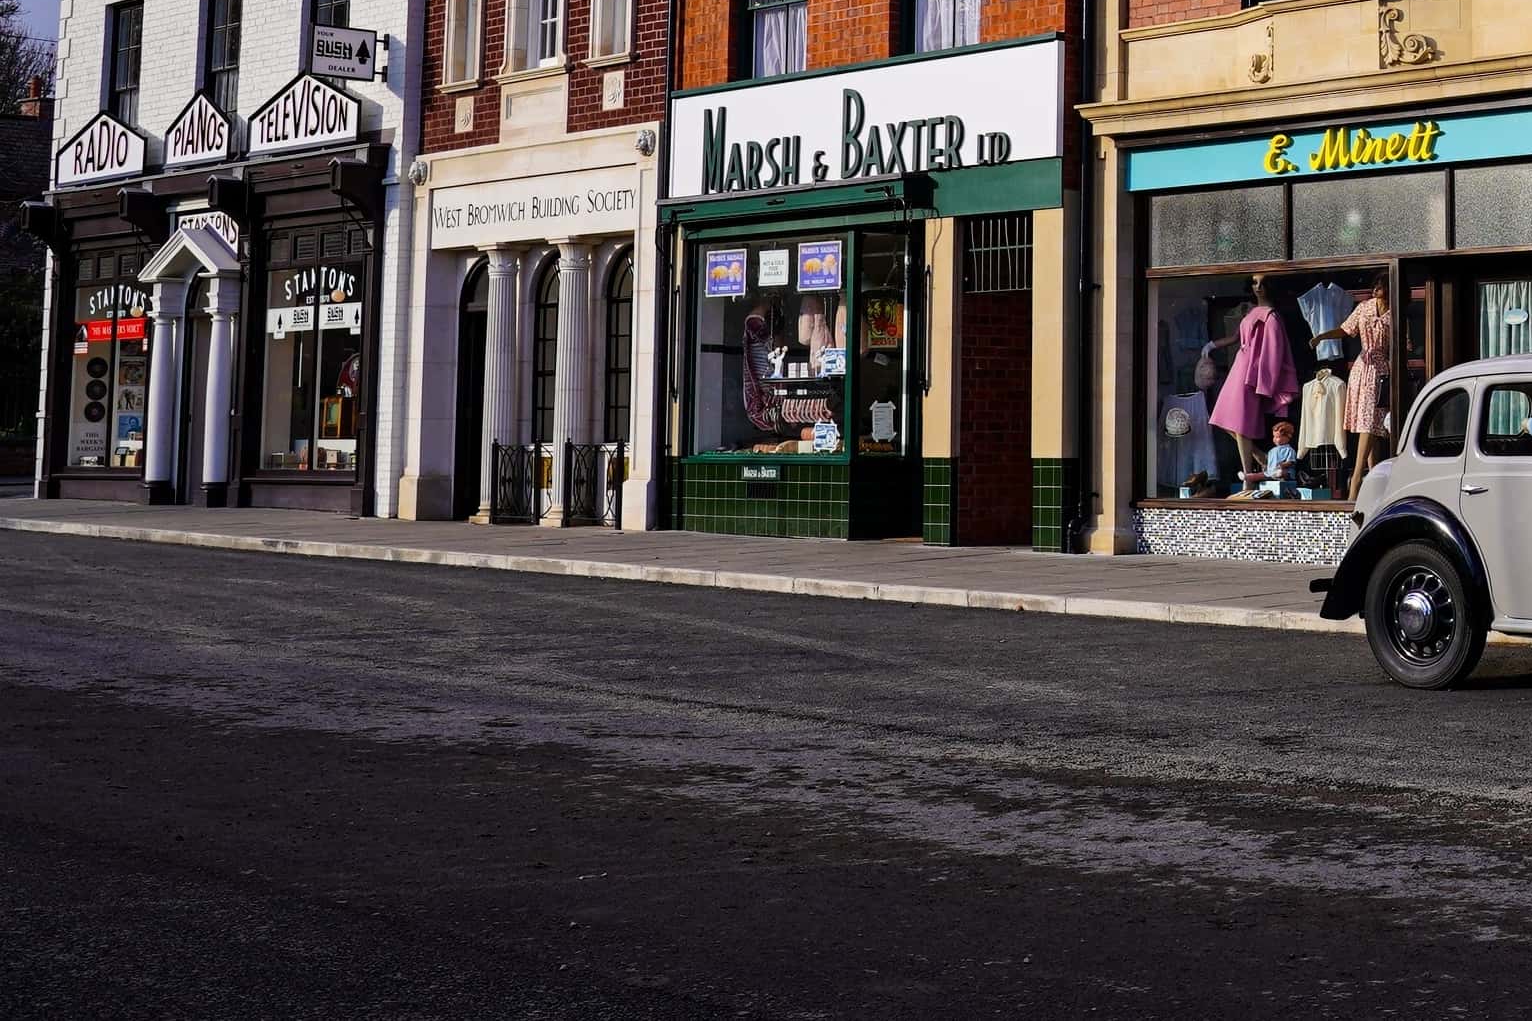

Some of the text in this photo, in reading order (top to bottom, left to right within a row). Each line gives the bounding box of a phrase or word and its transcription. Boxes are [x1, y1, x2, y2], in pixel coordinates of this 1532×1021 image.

[315, 39, 353, 60] BUSH
[328, 65, 356, 73] DEALER
[173, 103, 225, 158] PIANOS
[259, 80, 349, 144] TELEVISION
[74, 120, 128, 175] RADIO
[702, 106, 801, 195] MARSH
[812, 150, 828, 182] &
[841, 88, 965, 180] BAXTER
[1264, 120, 1444, 176] E. Minett
[433, 188, 637, 229] WEST BROMWICH BUILDING SOCIETY
